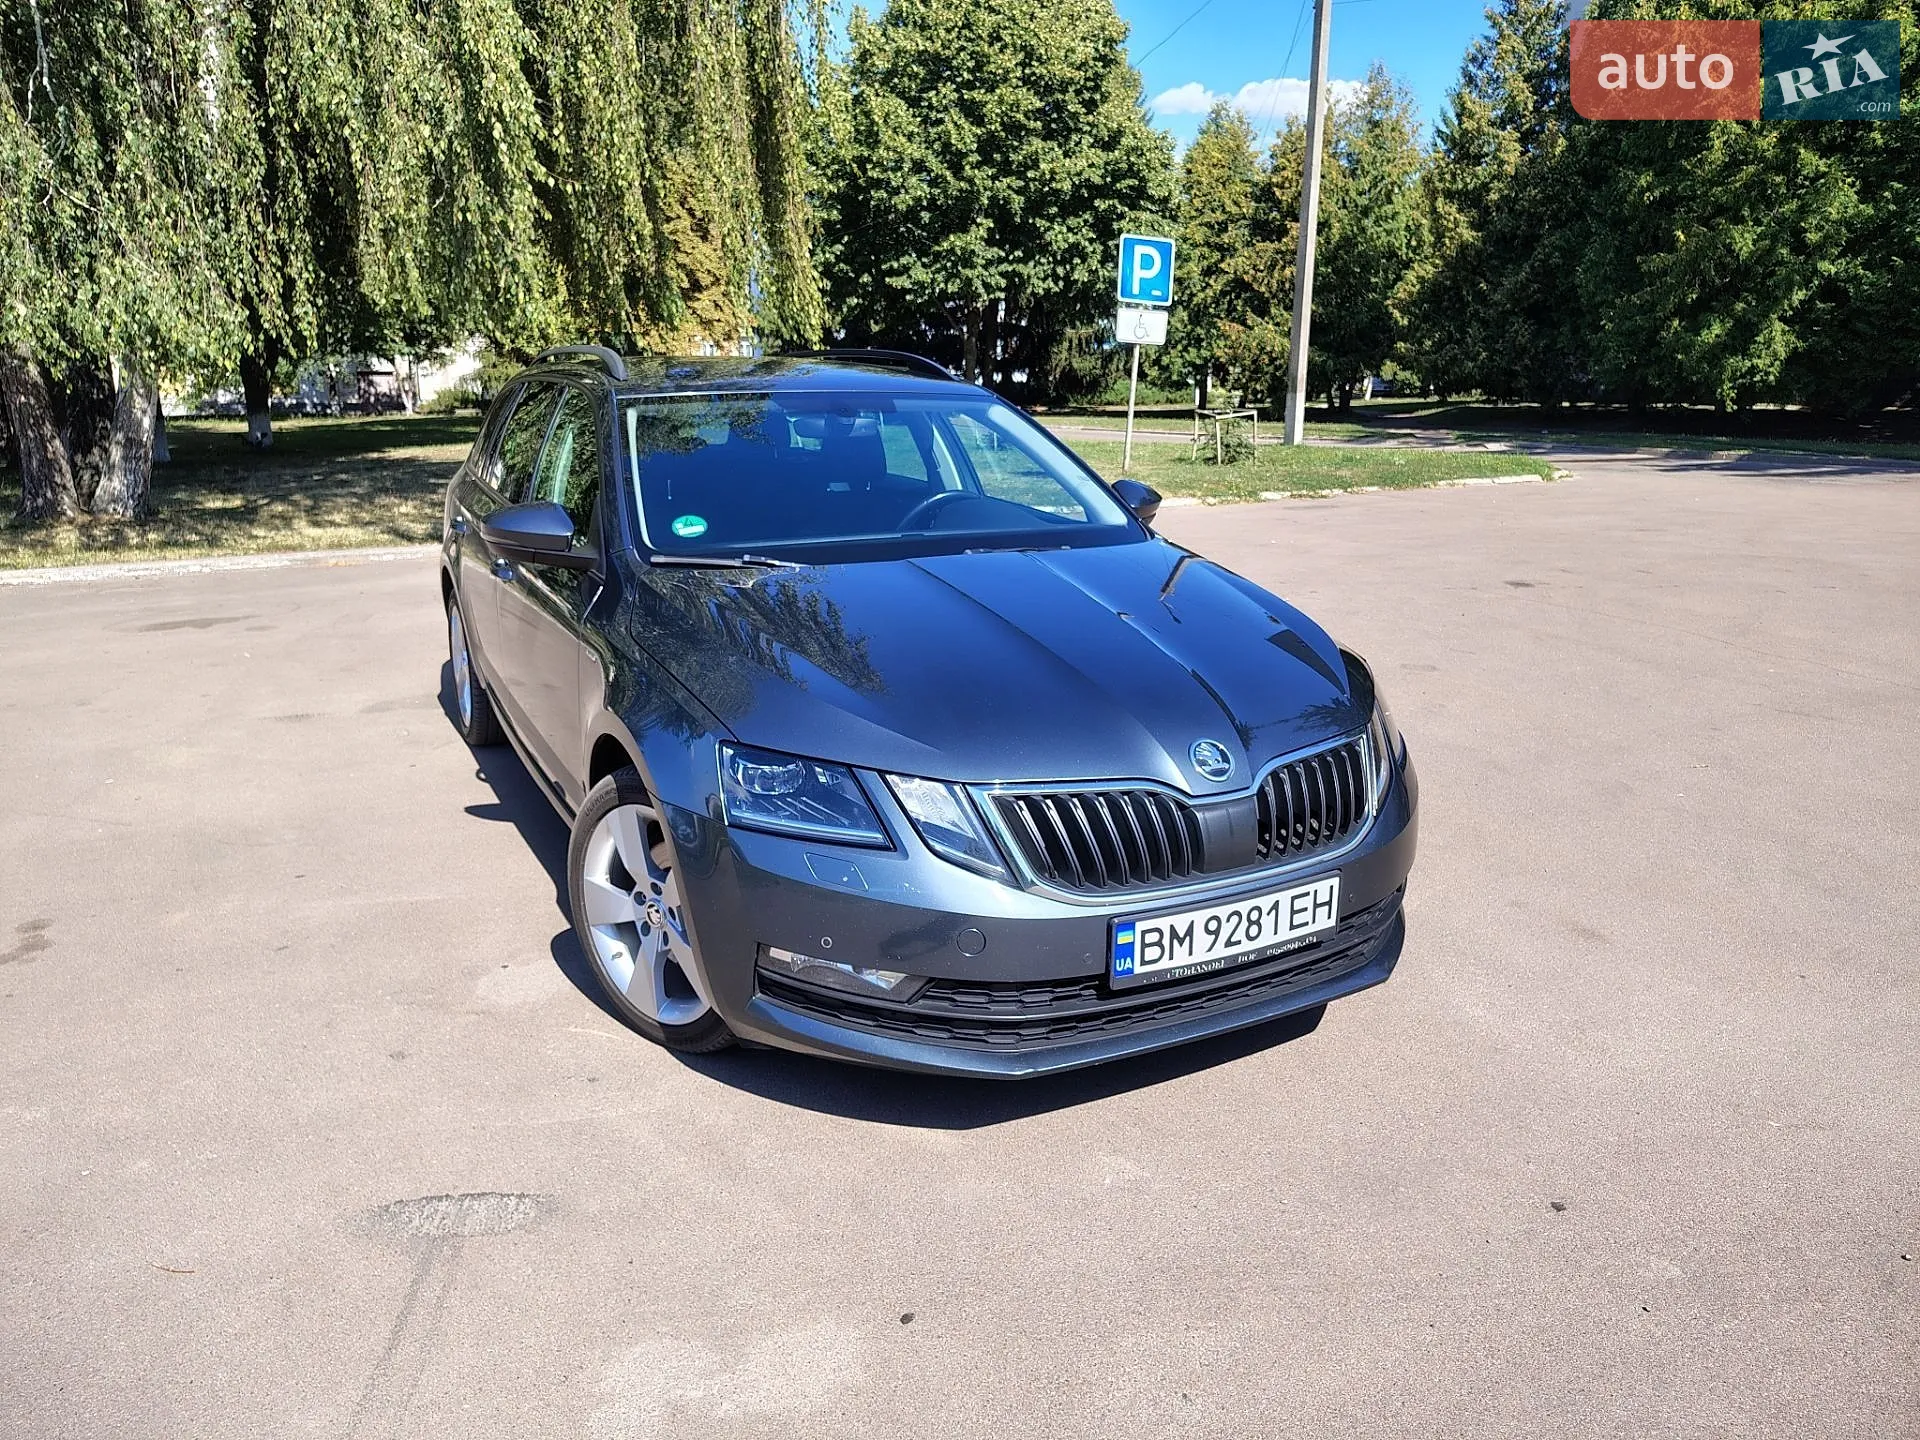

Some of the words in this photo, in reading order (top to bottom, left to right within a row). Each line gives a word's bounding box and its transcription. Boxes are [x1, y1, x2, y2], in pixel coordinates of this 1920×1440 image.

[1132, 244, 1162, 295] P
[1140, 919, 1195, 967] BM
[1203, 900, 1280, 953] 9281
[1289, 885, 1334, 931] EH
[1116, 957, 1133, 971] UA
